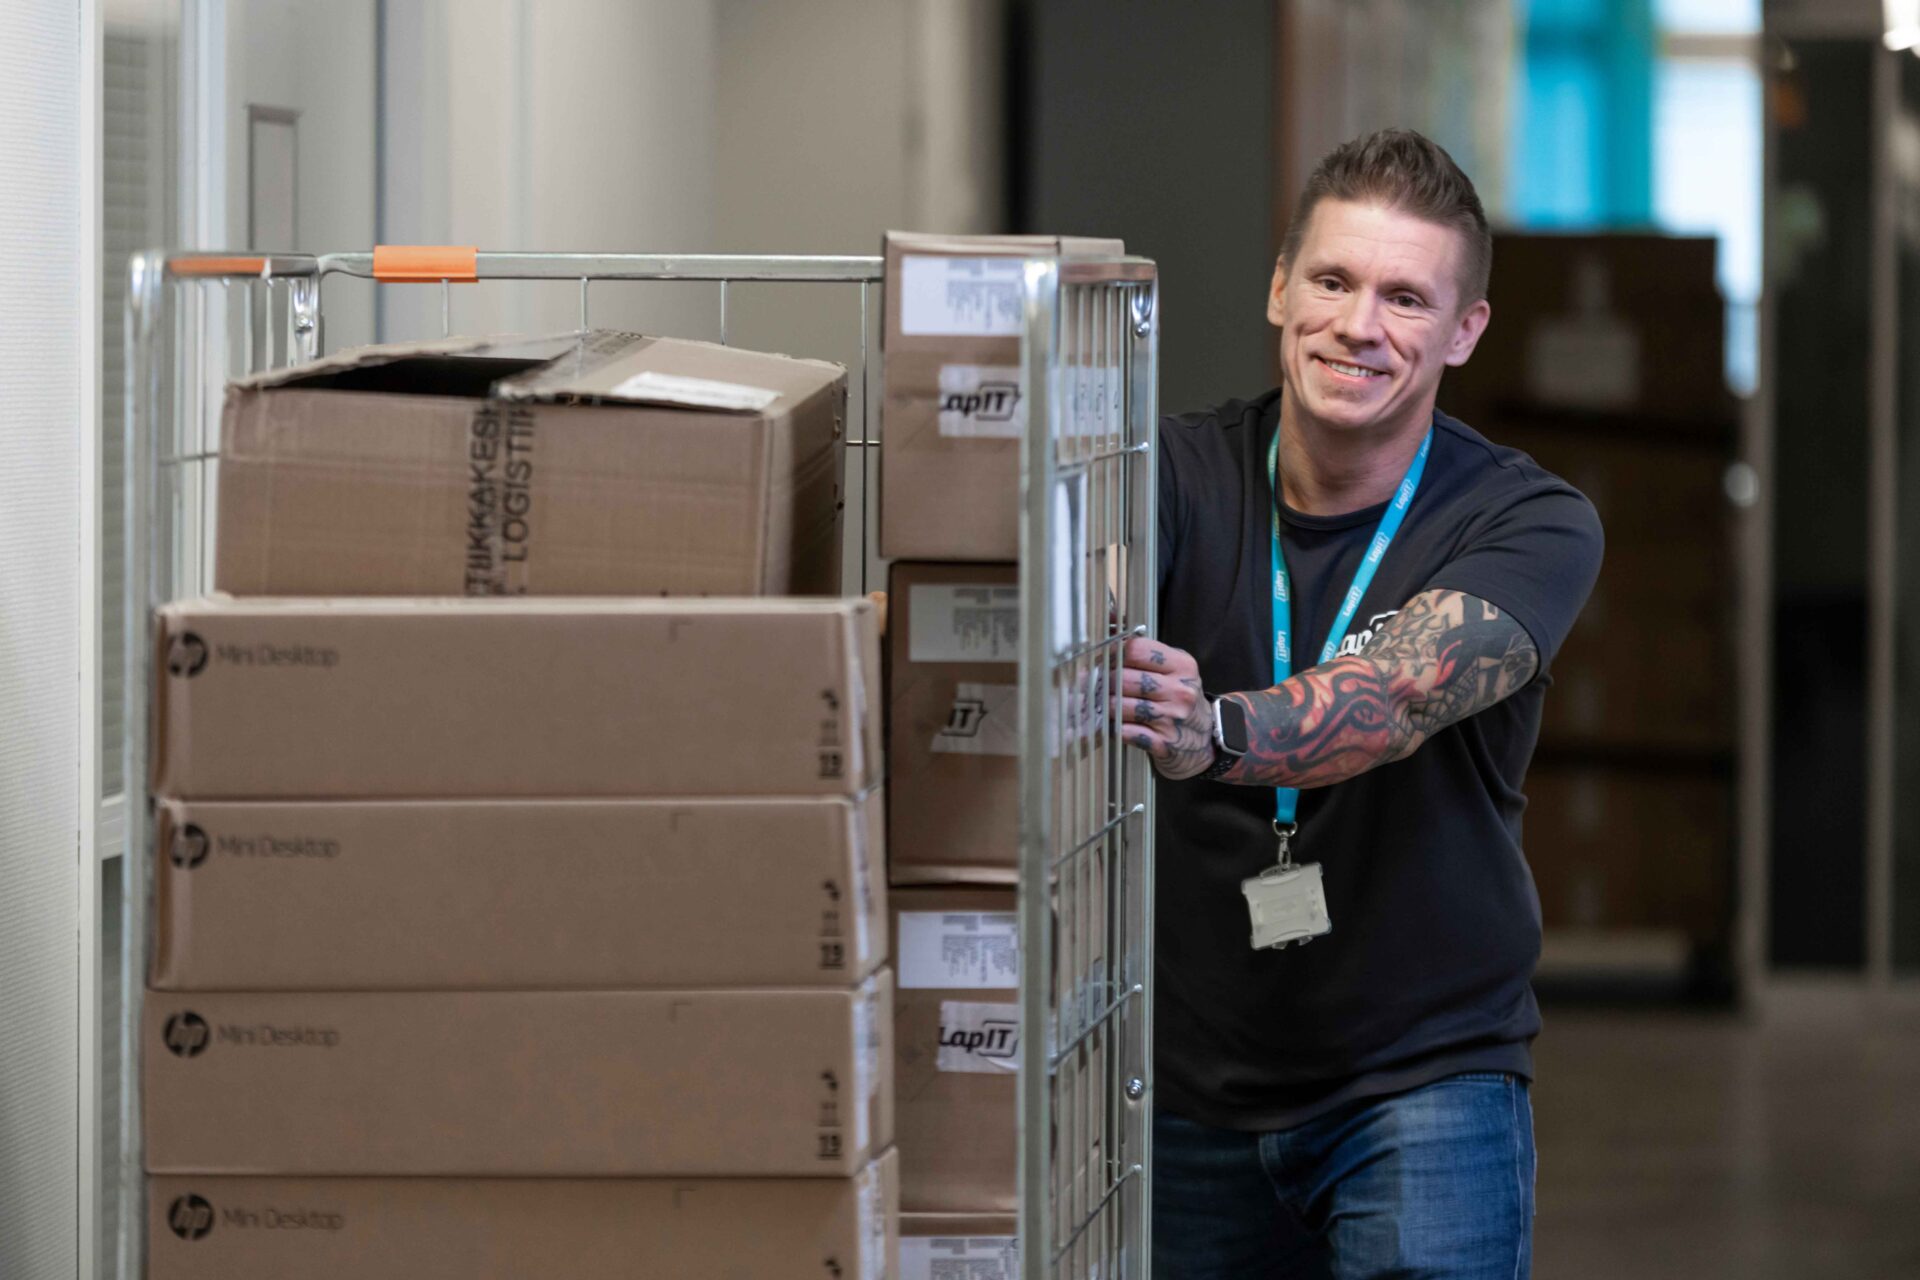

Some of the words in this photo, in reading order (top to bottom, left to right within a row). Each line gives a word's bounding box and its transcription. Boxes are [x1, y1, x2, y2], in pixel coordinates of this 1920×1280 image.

[1395, 479, 1414, 510] LapIT
[1368, 532, 1388, 563] LapIT
[1275, 570, 1288, 599] LapIT
[1342, 587, 1362, 617] LapIT
[1276, 631, 1289, 660] LapIT
